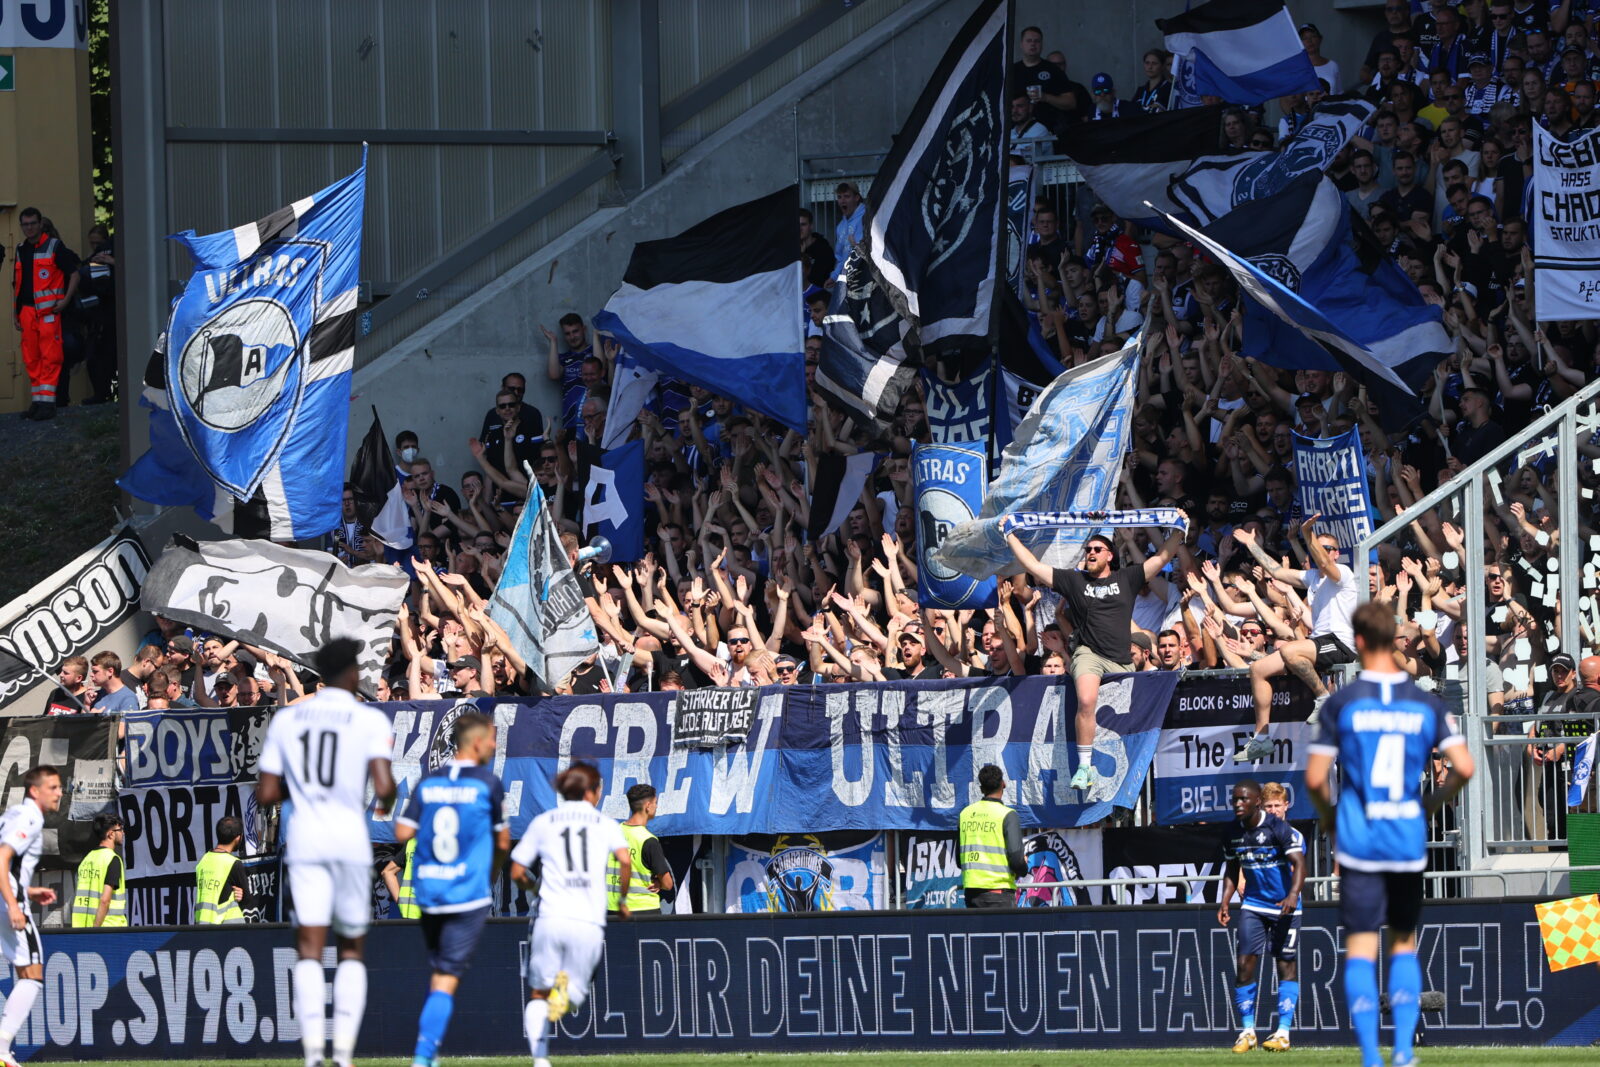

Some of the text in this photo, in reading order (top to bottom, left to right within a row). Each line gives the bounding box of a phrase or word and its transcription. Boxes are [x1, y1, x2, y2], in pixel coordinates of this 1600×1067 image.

[1561, 171, 1591, 187] HASS
[204, 254, 307, 304] ULTRAS
[244, 348, 262, 376] A
[1297, 446, 1360, 482] AVANTI
[582, 464, 628, 541] A
[1302, 482, 1366, 516] ULTRAS
[1008, 509, 1180, 527] LOKAL CREW
[682, 688, 754, 711] STÄRKER ALS
[1179, 691, 1291, 711] BLOCK 6 SINC 998
[701, 709, 753, 732] AUFLAGE
[128, 718, 230, 784] BOYS
[298, 728, 338, 788] 10
[825, 677, 1135, 808] ULTRAS
[1179, 731, 1293, 769] The Fm
[1370, 732, 1406, 801] 4
[1181, 782, 1295, 814] BIELED
[119, 784, 247, 870] PORTA
[432, 805, 460, 865] 8
[961, 821, 996, 834] ORDNER
[559, 826, 589, 873] 11
[125, 886, 170, 927] ALLE
[924, 890, 957, 906] ULTRS
[1287, 929, 1297, 948] 7
[639, 938, 734, 1038] DIR
[746, 934, 914, 1037] DEINE
[928, 930, 1122, 1035] NEUEN
[1136, 922, 1546, 1032] FANRKEL!
